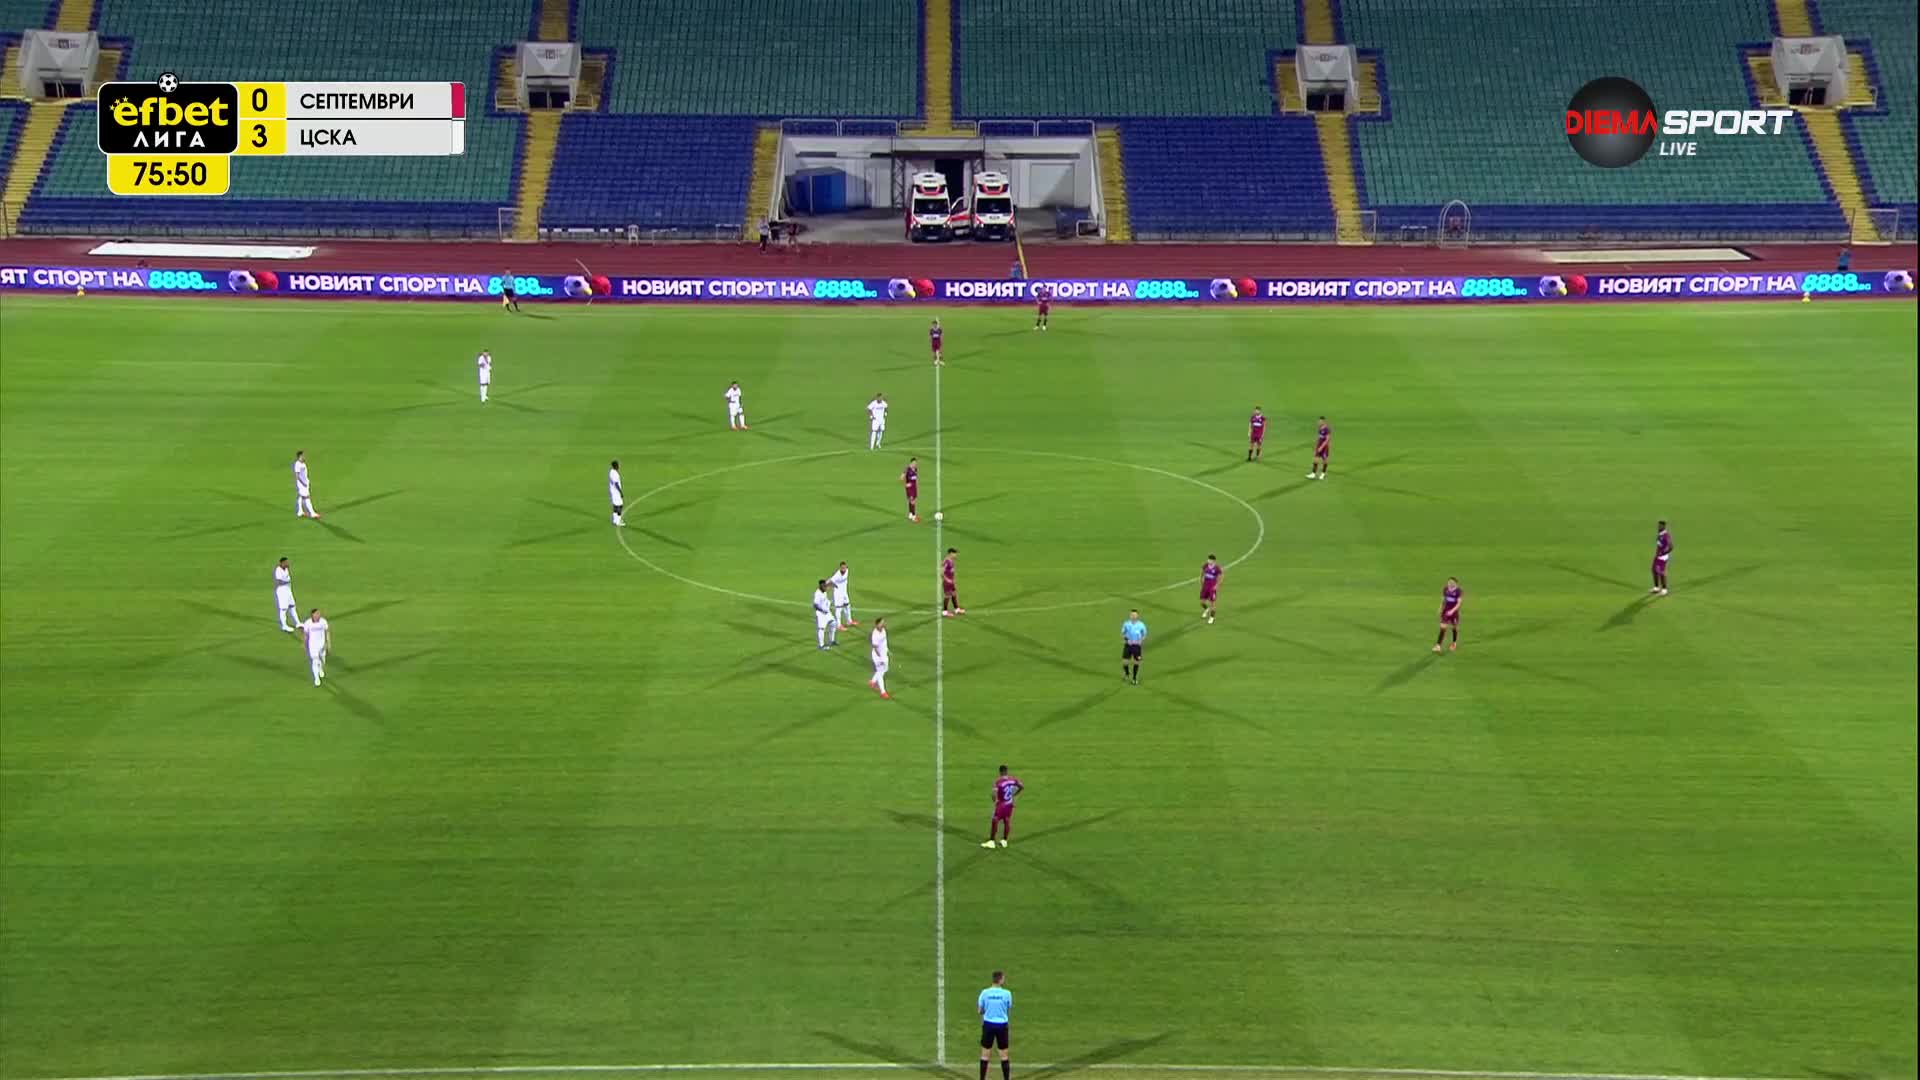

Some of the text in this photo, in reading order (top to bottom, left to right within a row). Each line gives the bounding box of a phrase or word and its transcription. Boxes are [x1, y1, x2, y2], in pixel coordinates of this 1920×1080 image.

[33, 269, 107, 286] СПОРТ
[112, 271, 144, 286] НА
[290, 275, 375, 291] НОВИЯТ
[379, 276, 449, 293] СПОРТ
[454, 278, 483, 293] НА
[1600, 277, 1685, 294] НОВИЯТ
[1689, 276, 1762, 293] СПОРТ
[1767, 275, 1797, 292] НА
[622, 279, 704, 296] НОВИЯТ
[708, 280, 776, 297] СПОРТ
[781, 281, 809, 296] НА
[945, 281, 1027, 297] НОВИЯТ
[1103, 282, 1131, 297] НА
[1268, 280, 1351, 297] НОВИЯТ
[1354, 280, 1424, 296] СПОРТ
[1428, 279, 1456, 295] НА
